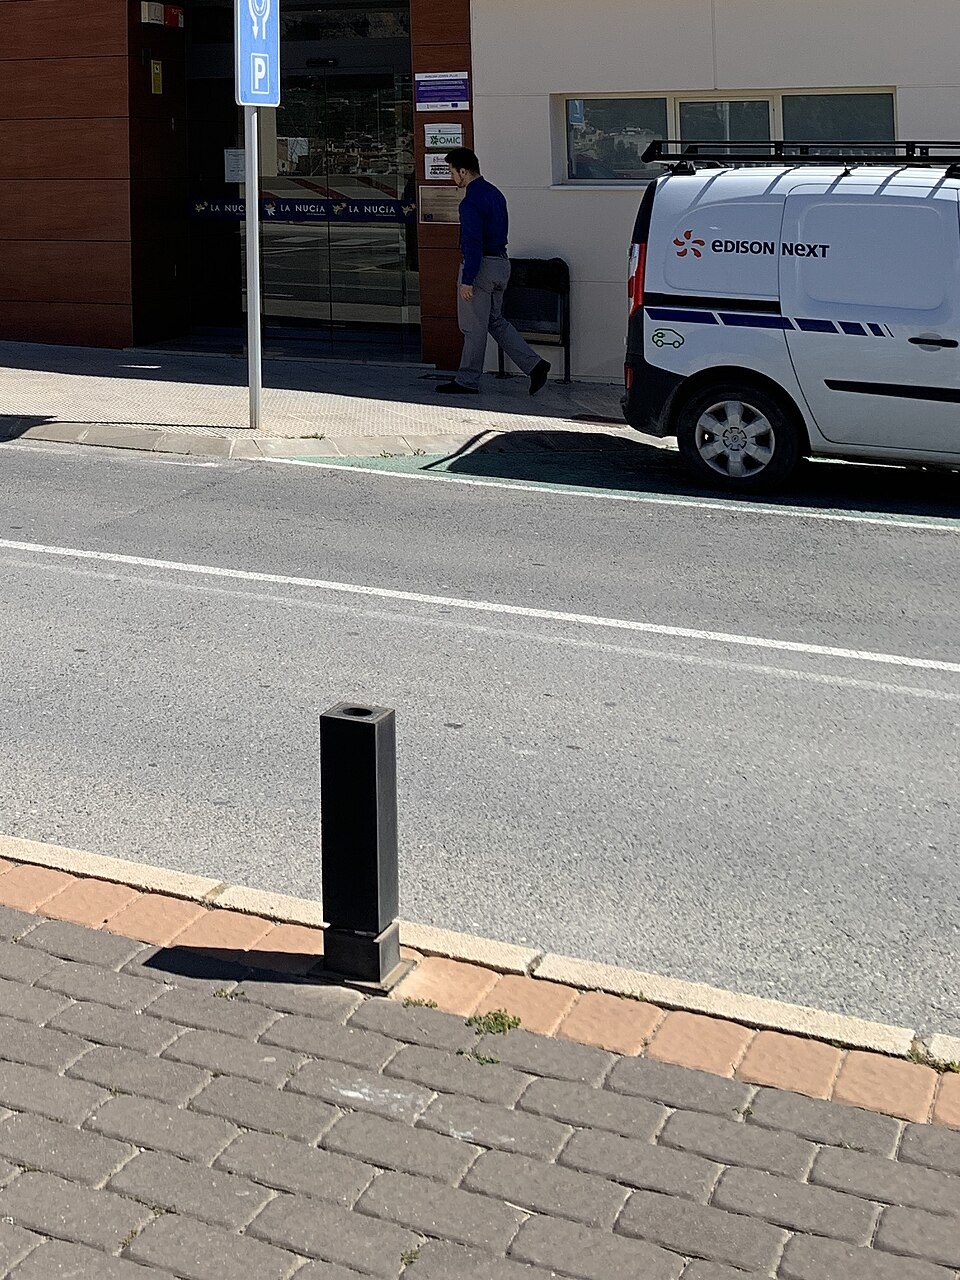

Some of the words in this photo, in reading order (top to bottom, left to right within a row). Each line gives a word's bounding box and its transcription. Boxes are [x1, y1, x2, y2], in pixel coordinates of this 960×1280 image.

[254, 57, 266, 90] P
[439, 136, 461, 145] OMIC
[210, 204, 220, 212] LA
[224, 204, 246, 212] NUC
[280, 204, 291, 212] LA
[348, 205, 359, 213] LA
